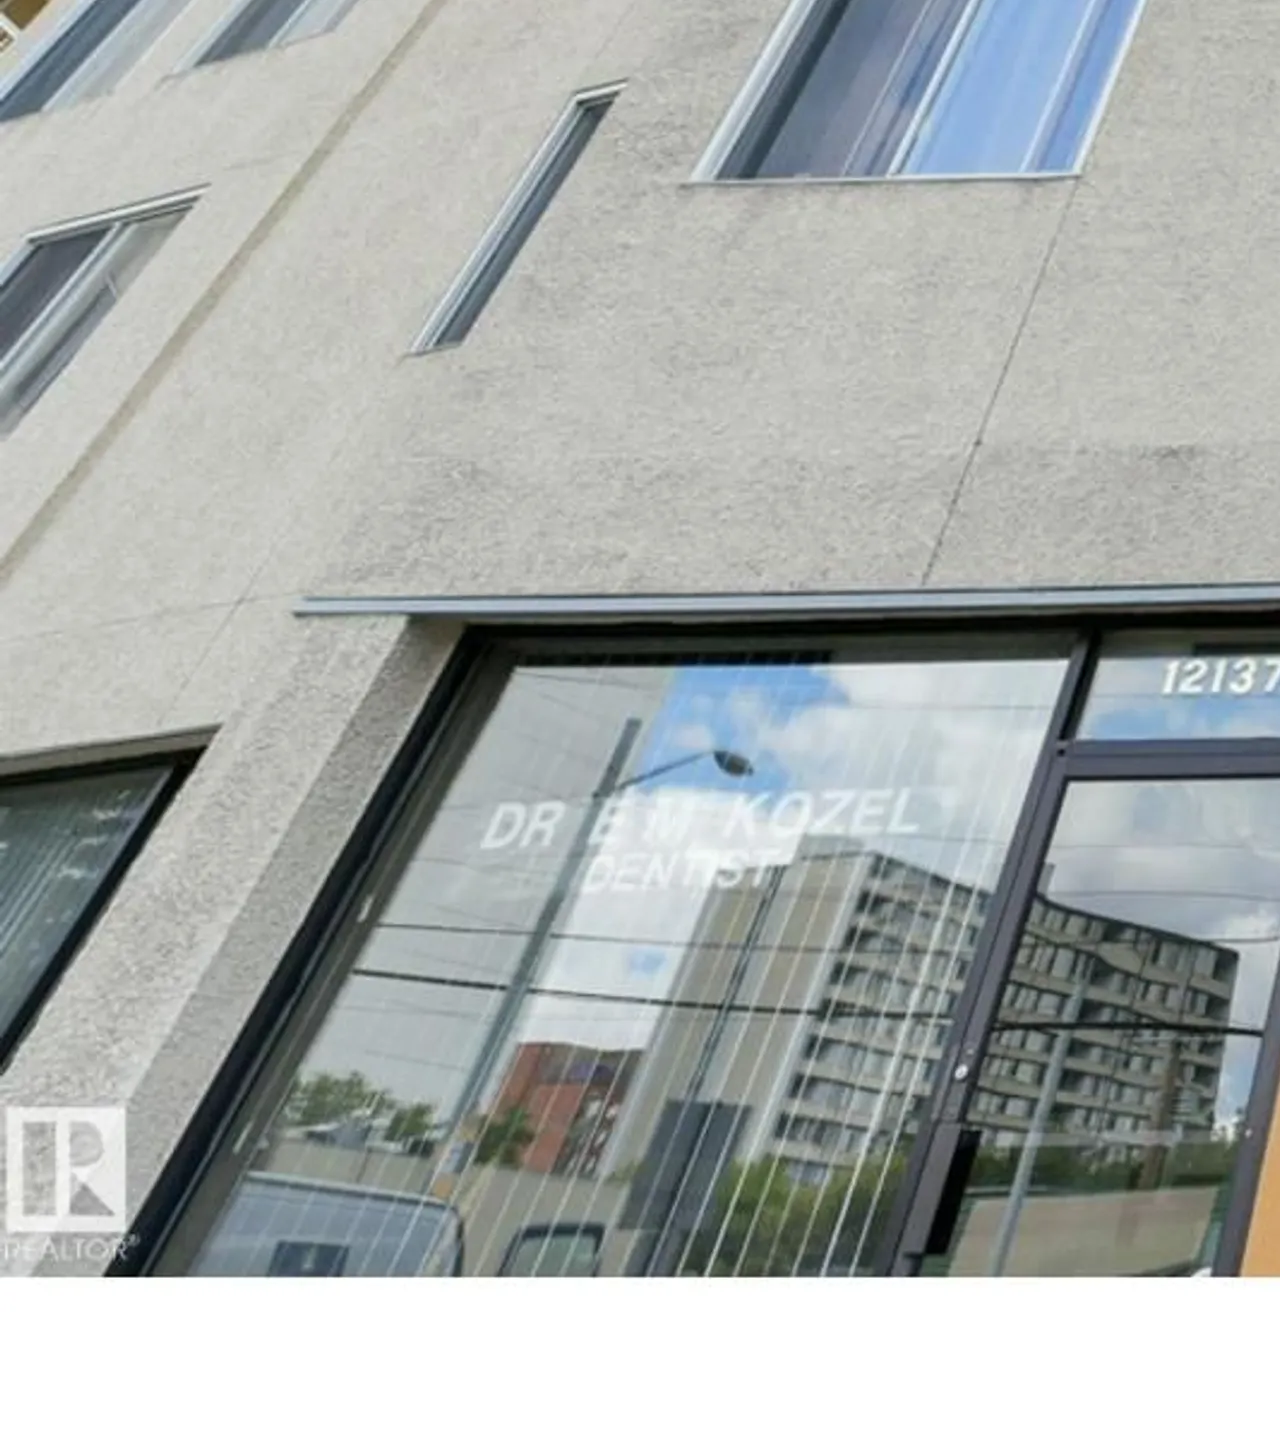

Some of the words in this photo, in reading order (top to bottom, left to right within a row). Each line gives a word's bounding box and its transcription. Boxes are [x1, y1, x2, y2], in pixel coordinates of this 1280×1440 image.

[480, 799, 568, 850] DR
[722, 787, 920, 839] KOZEL
[582, 847, 787, 895] DENTIST
